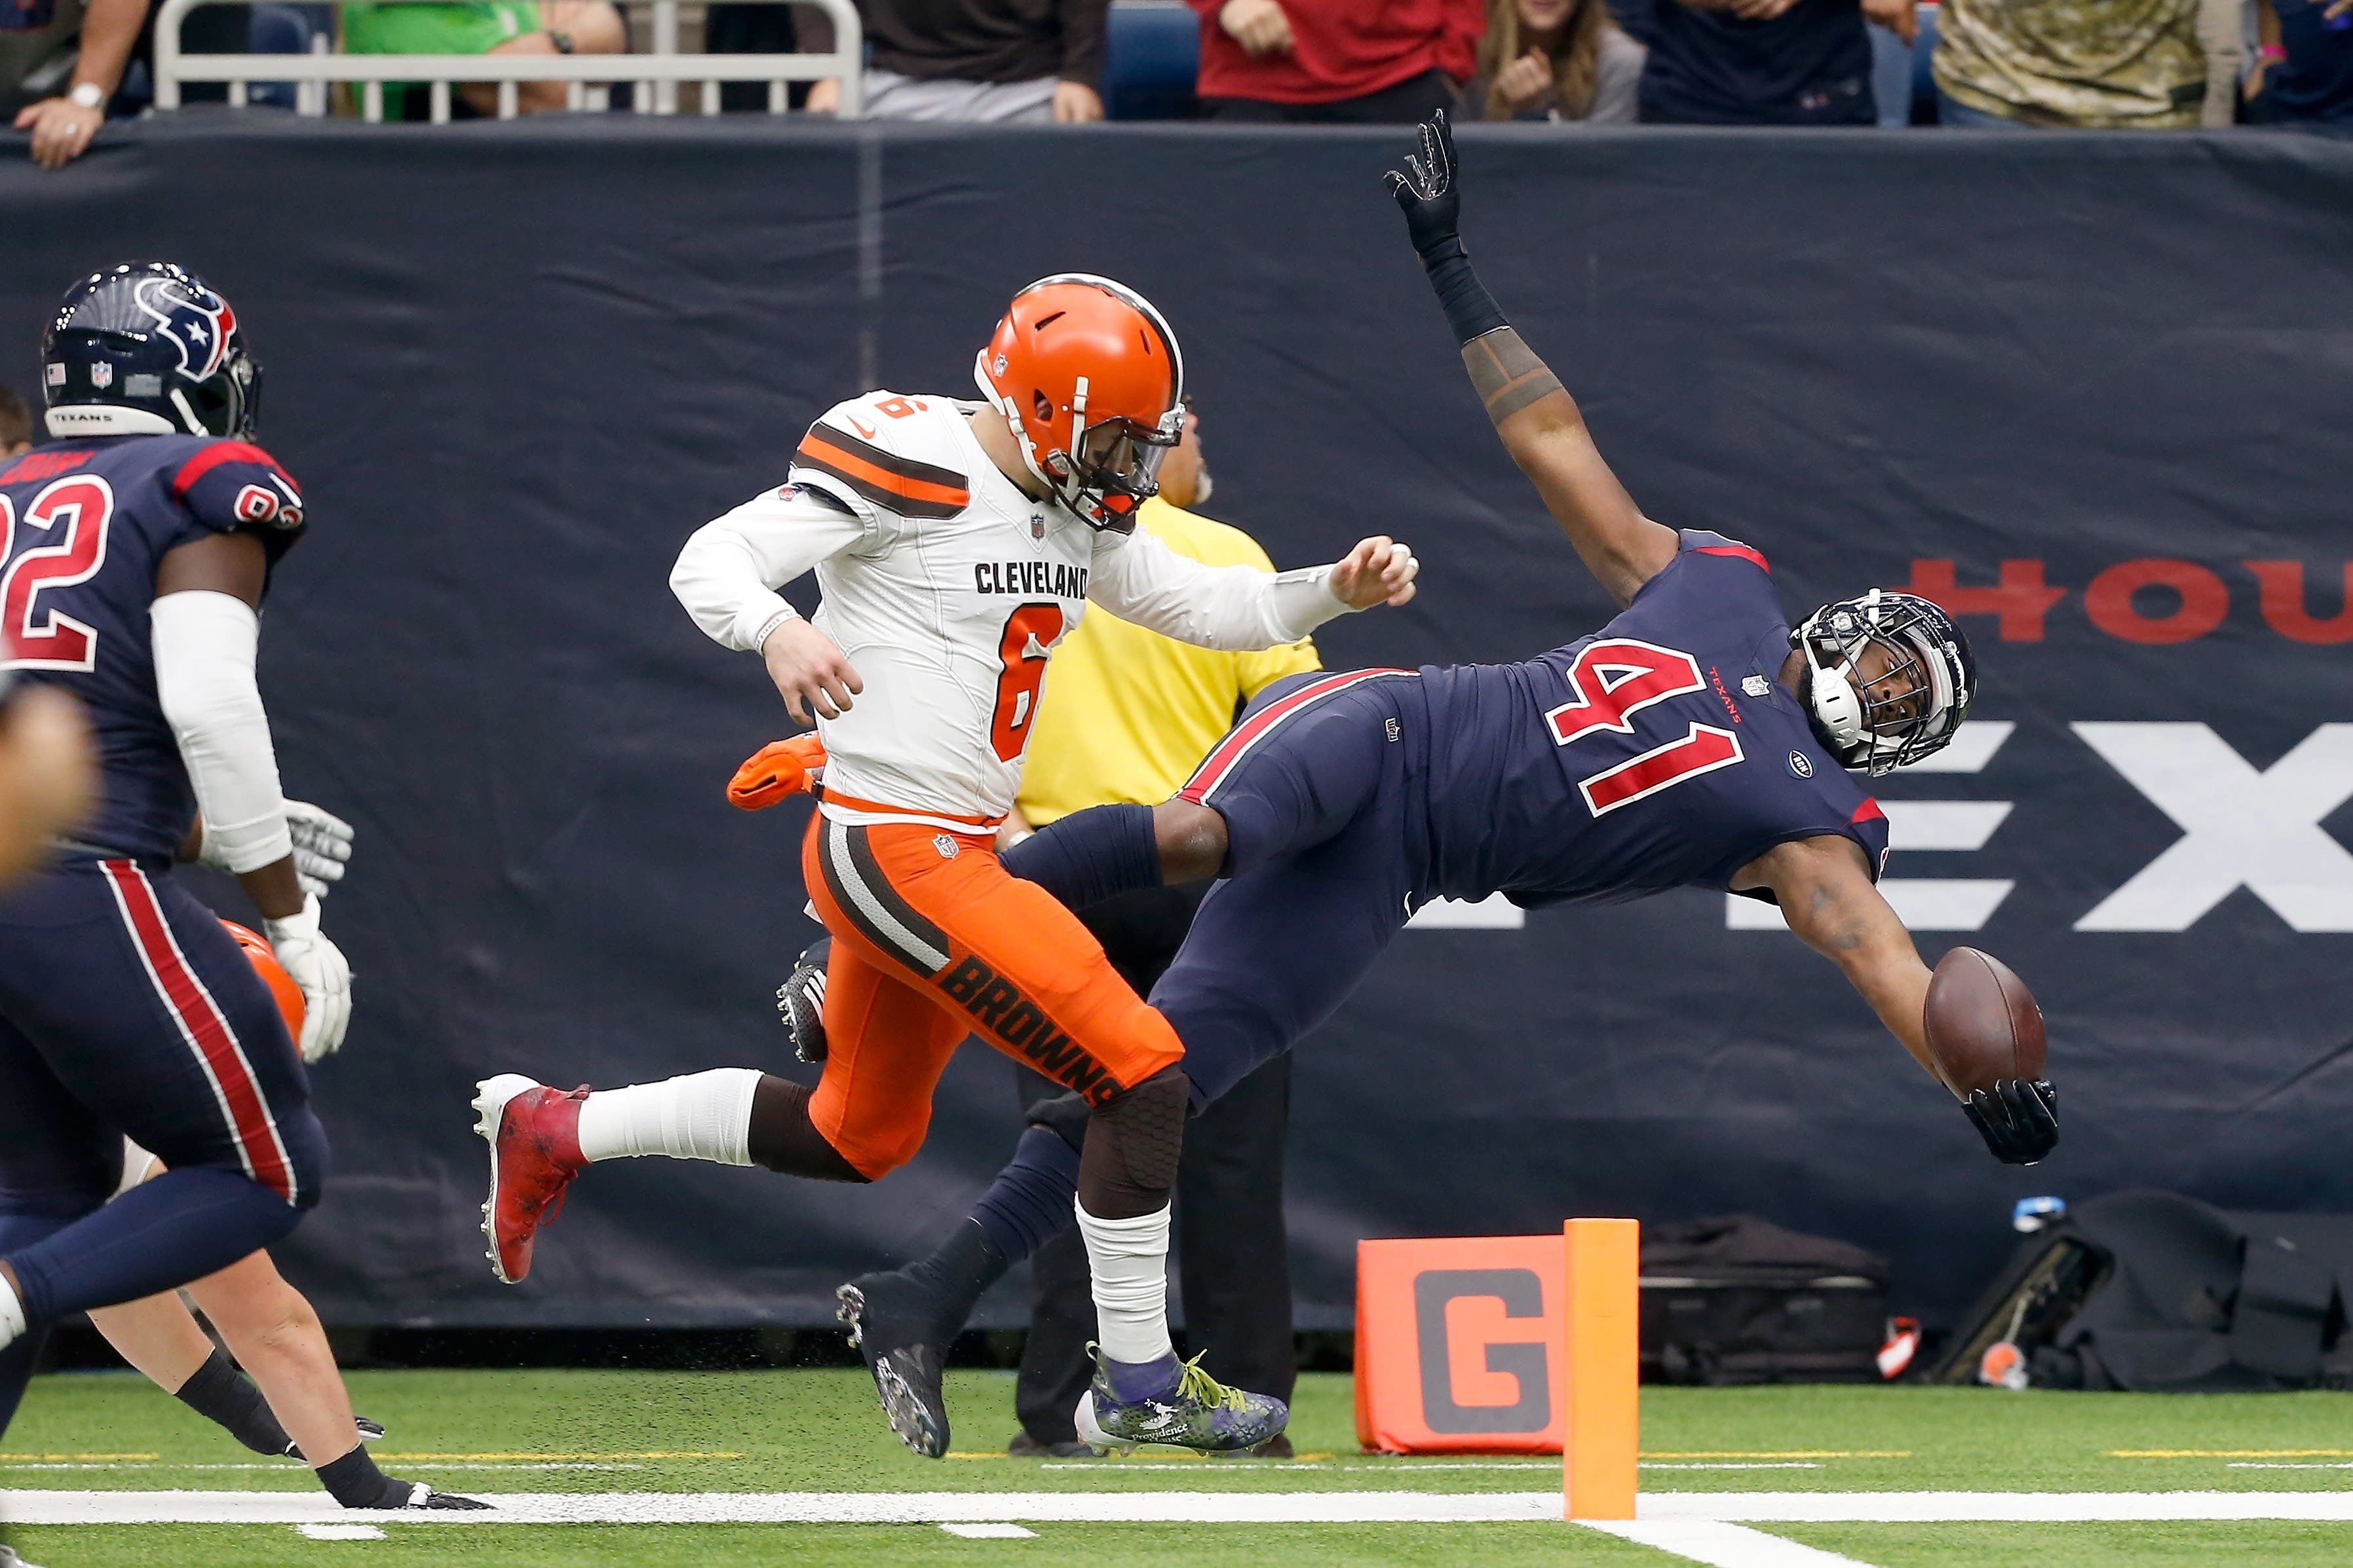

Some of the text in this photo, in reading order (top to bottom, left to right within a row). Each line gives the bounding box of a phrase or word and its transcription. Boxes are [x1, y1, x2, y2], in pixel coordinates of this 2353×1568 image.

[54, 413, 113, 423] TEXANS
[874, 396, 928, 419] 6
[0, 473, 115, 673] 2
[975, 562, 1088, 600] CLEVELAND
[1892, 558, 2353, 645] HOU
[990, 602, 1064, 763] 6
[1709, 666, 1742, 724] TEXANS
[1544, 638, 1746, 819] 41
[1413, 1268, 1551, 1435] G
[1132, 1423, 1188, 1440] Providence
